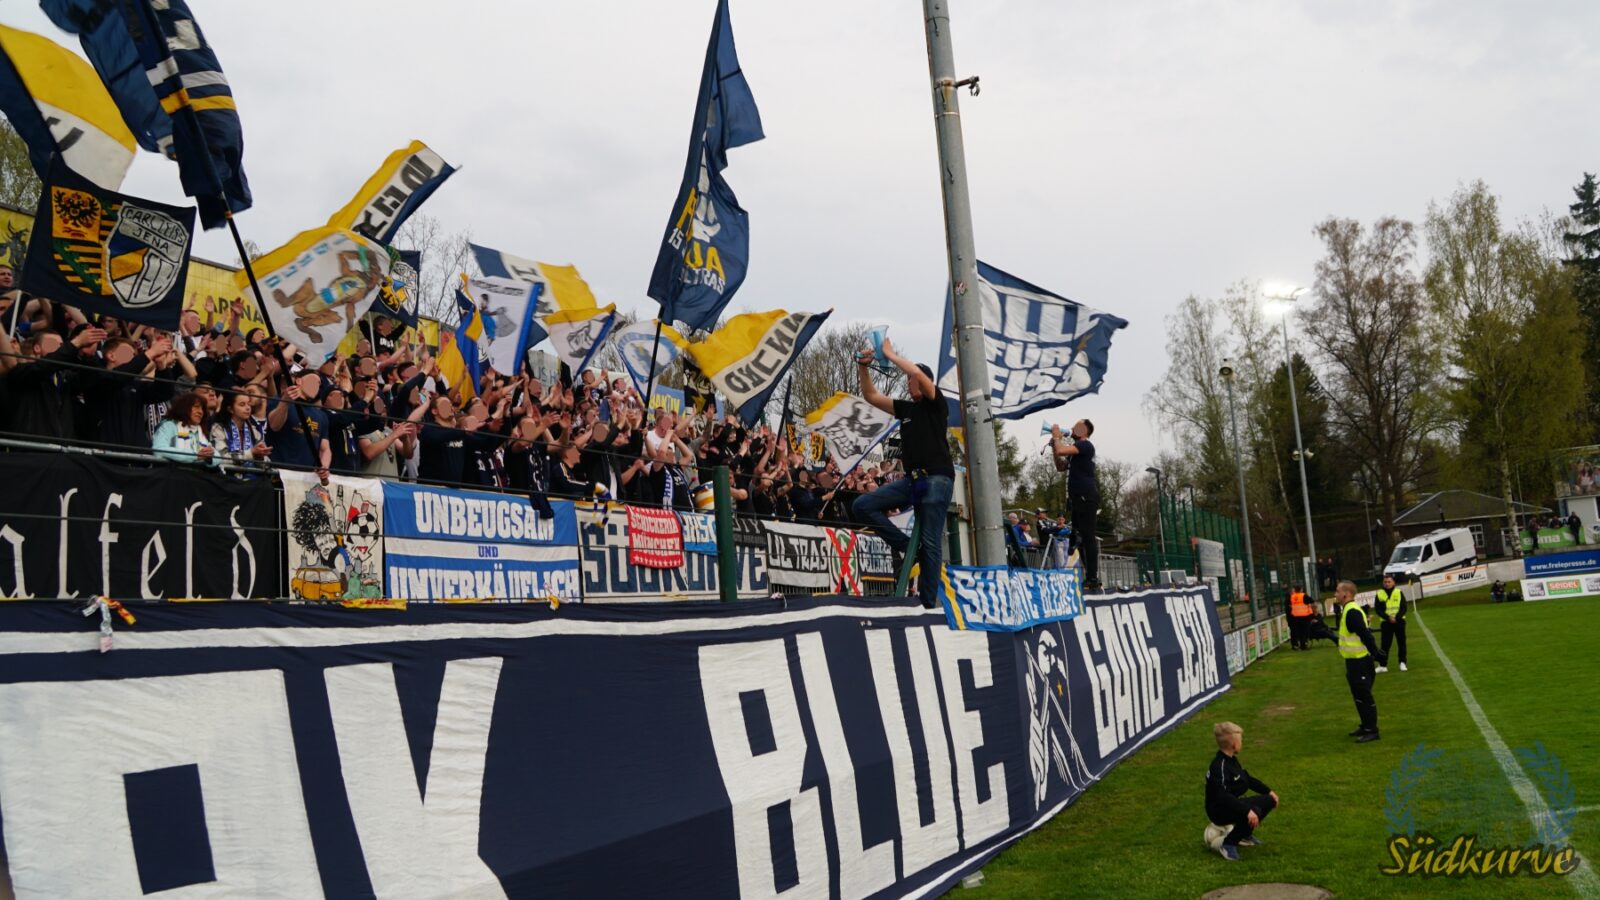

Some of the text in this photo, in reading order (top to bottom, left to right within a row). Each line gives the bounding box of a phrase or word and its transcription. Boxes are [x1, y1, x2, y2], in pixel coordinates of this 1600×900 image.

[132, 229, 170, 253] JENA
[679, 267, 726, 296] LTRAS
[630, 513, 679, 534] SCHICKERIA
[631, 533, 681, 556] MÜNCHEN
[1523, 534, 1561, 546] eima
[478, 545, 499, 558] UND
[767, 532, 828, 572] ULTRAS
[1458, 569, 1476, 581] KWV
[1531, 559, 1597, 571] www.freiepresse.de
[698, 624, 1011, 900] BLUE
[1073, 601, 1165, 759] GANG
[1164, 593, 1219, 705] JENA
